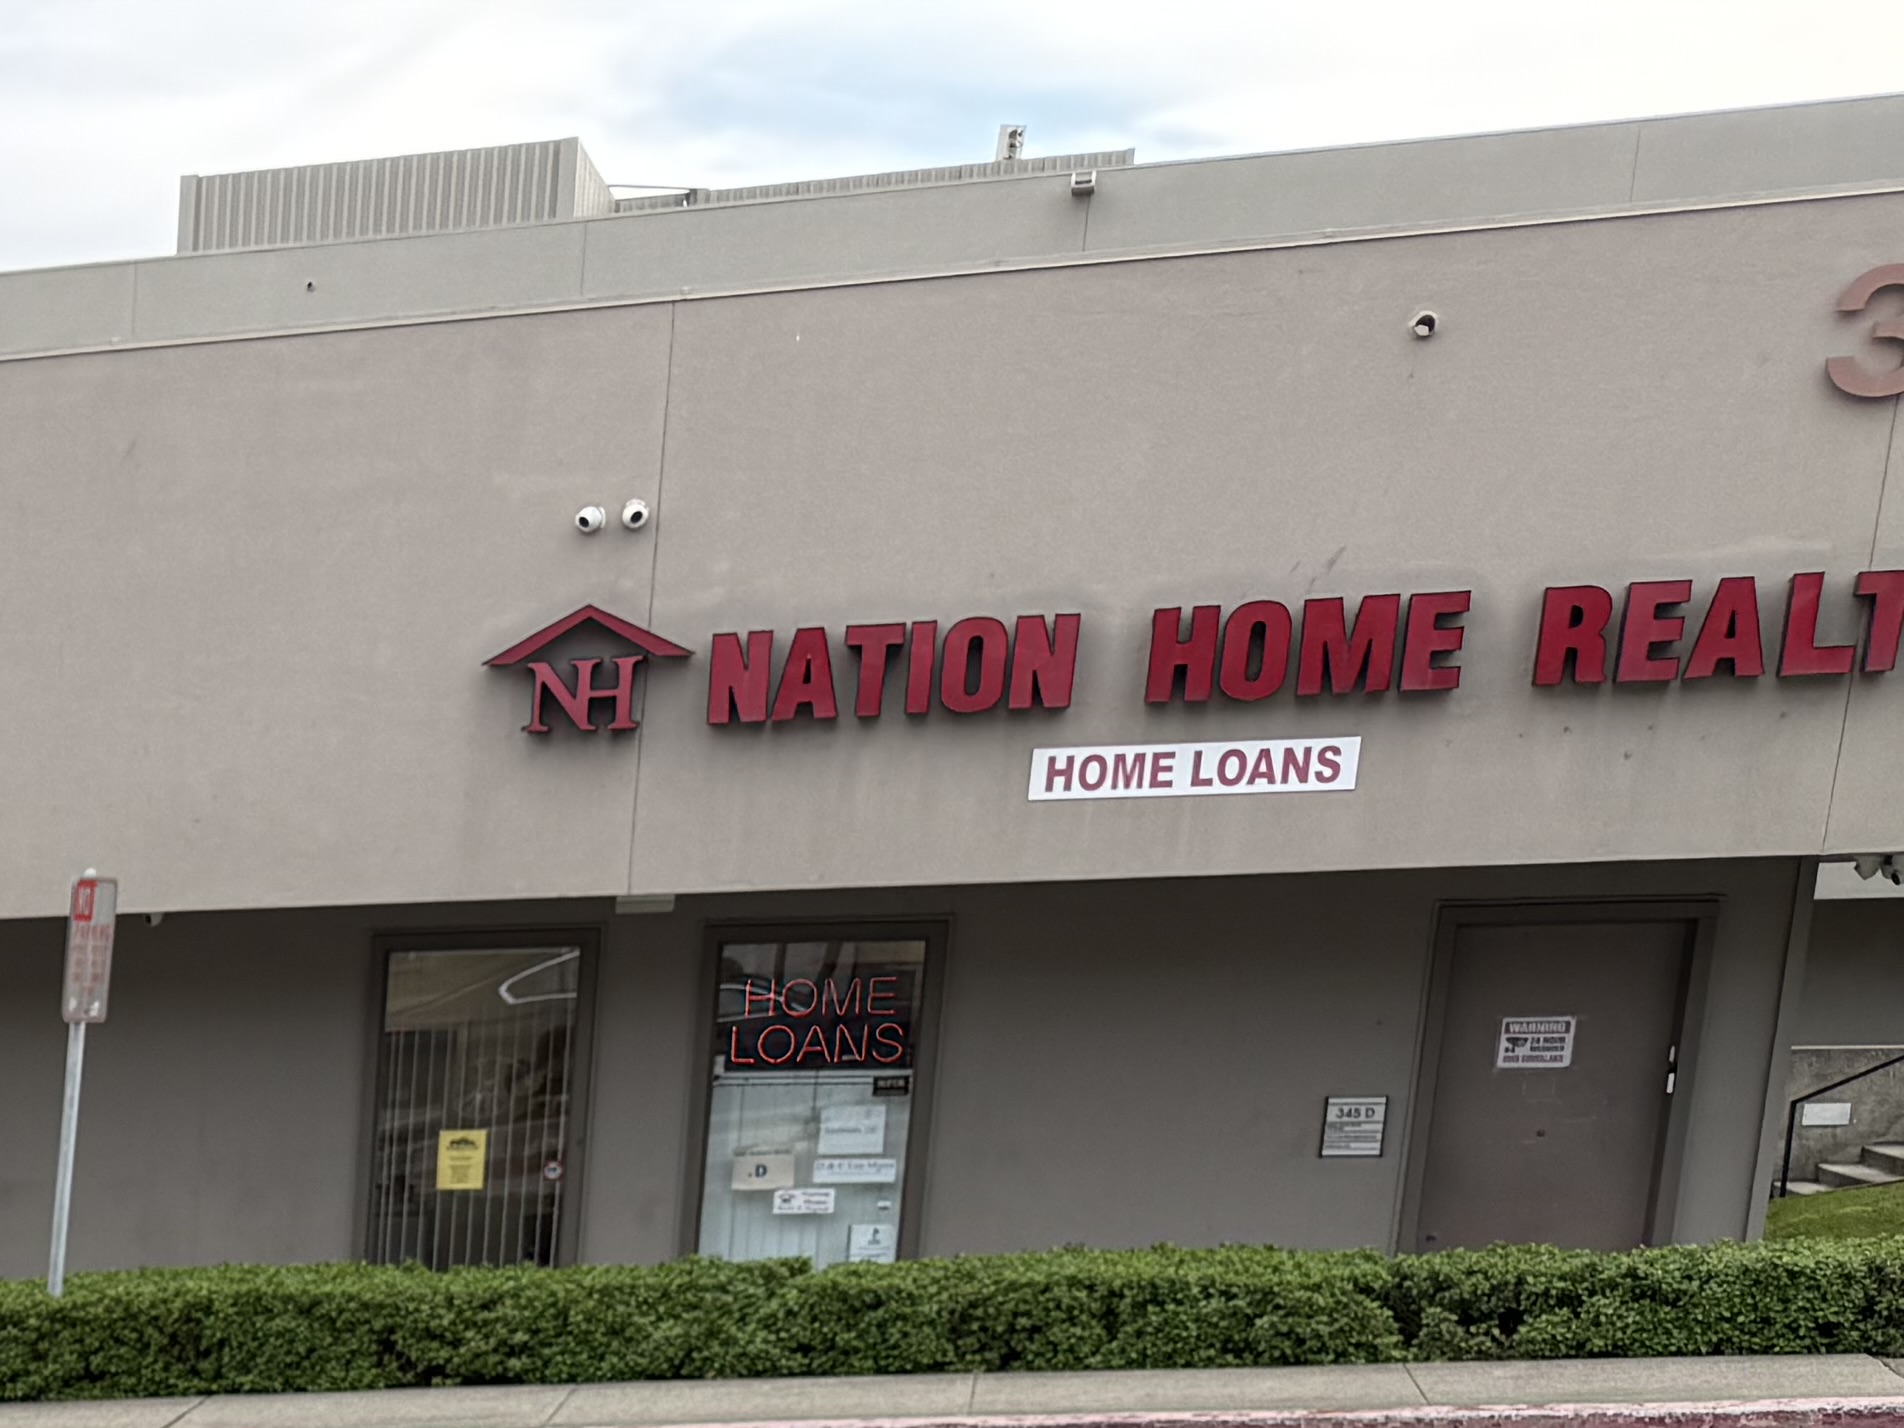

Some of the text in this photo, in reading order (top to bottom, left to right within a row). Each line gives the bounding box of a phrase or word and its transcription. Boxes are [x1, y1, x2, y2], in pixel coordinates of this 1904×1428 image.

[707, 570, 1904, 726] NATION HOME REALT
[521, 655, 646, 733] NH
[1044, 745, 1343, 793] HOME LOANS
[743, 976, 897, 1019] HOME
[729, 1022, 905, 1065] LOANS
[1335, 1107, 1376, 1119] 345 D
